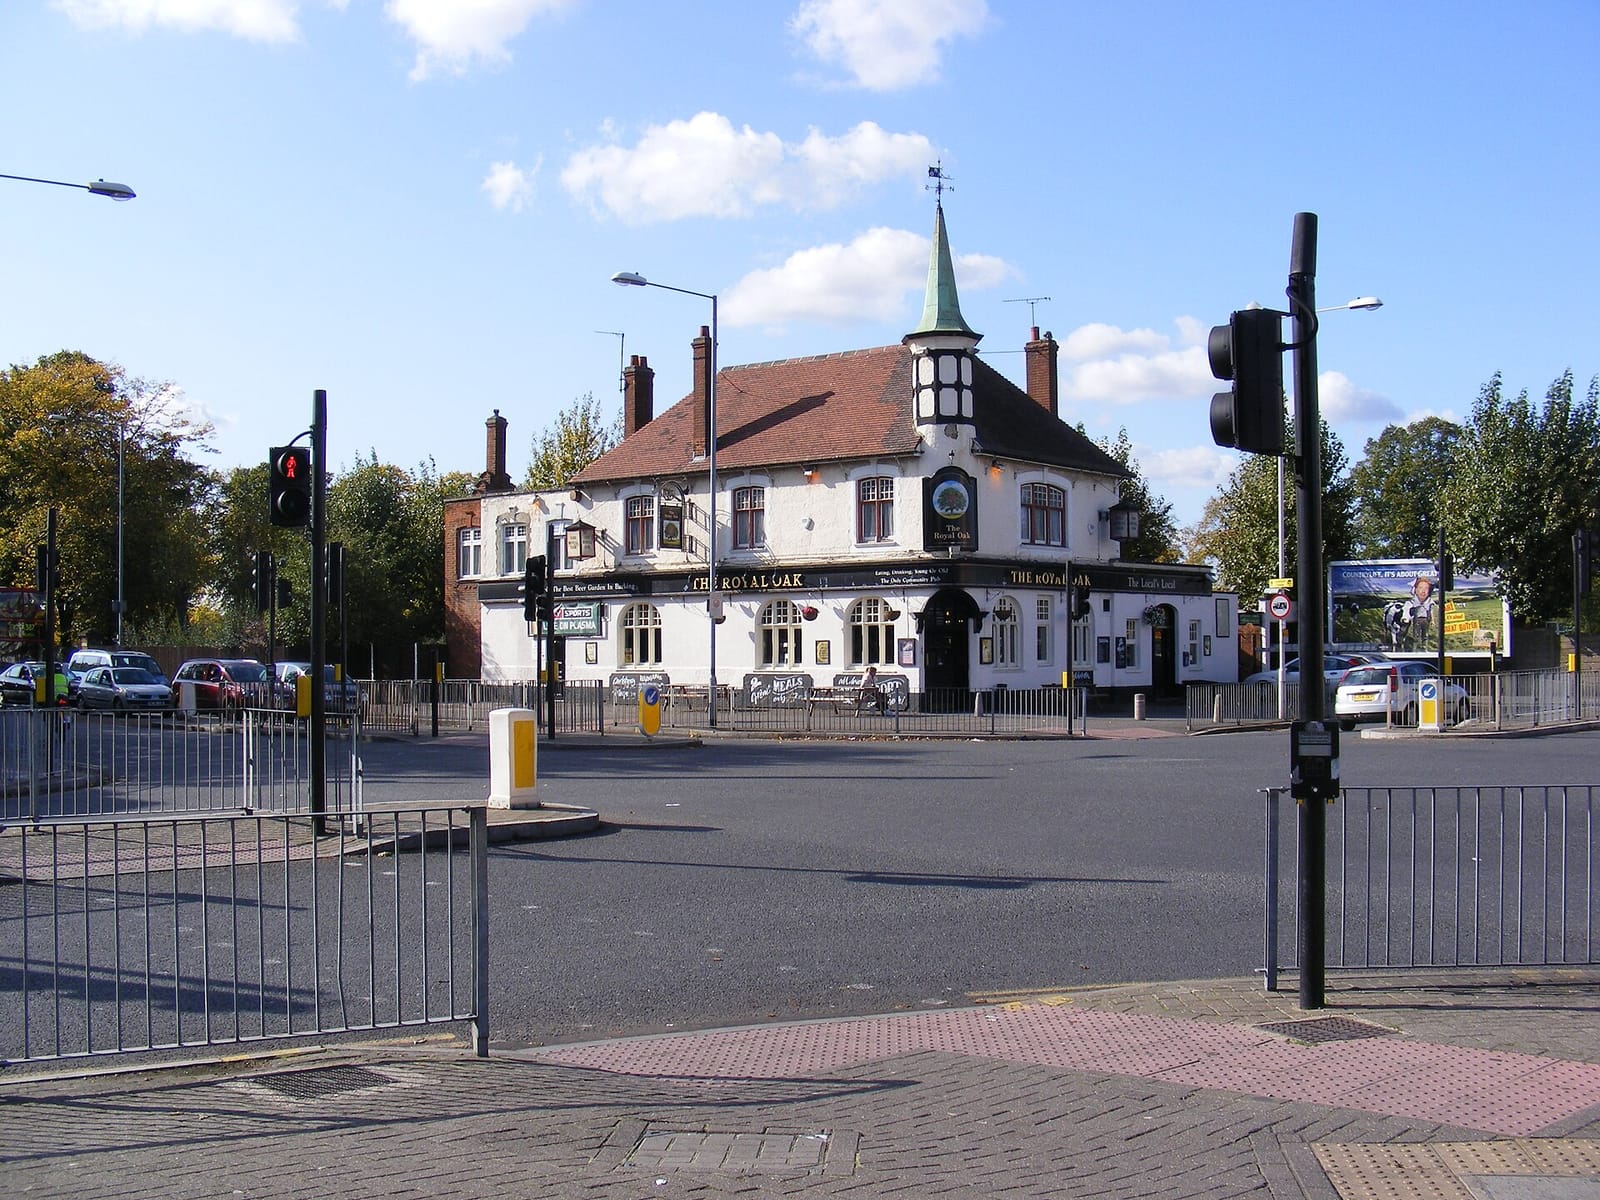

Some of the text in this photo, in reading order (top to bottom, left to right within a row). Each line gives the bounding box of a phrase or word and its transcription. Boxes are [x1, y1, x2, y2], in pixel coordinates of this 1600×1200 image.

[934, 532, 955, 540] Royal
[722, 575, 768, 590] ROYAL
[772, 574, 803, 587] OAK
[1010, 570, 1032, 584] THE
[1036, 572, 1066, 585] ROYAL
[1128, 576, 1176, 589] The Local's Local
[542, 621, 596, 630] LIE ON PLASMA
[773, 678, 803, 692] MEALS
